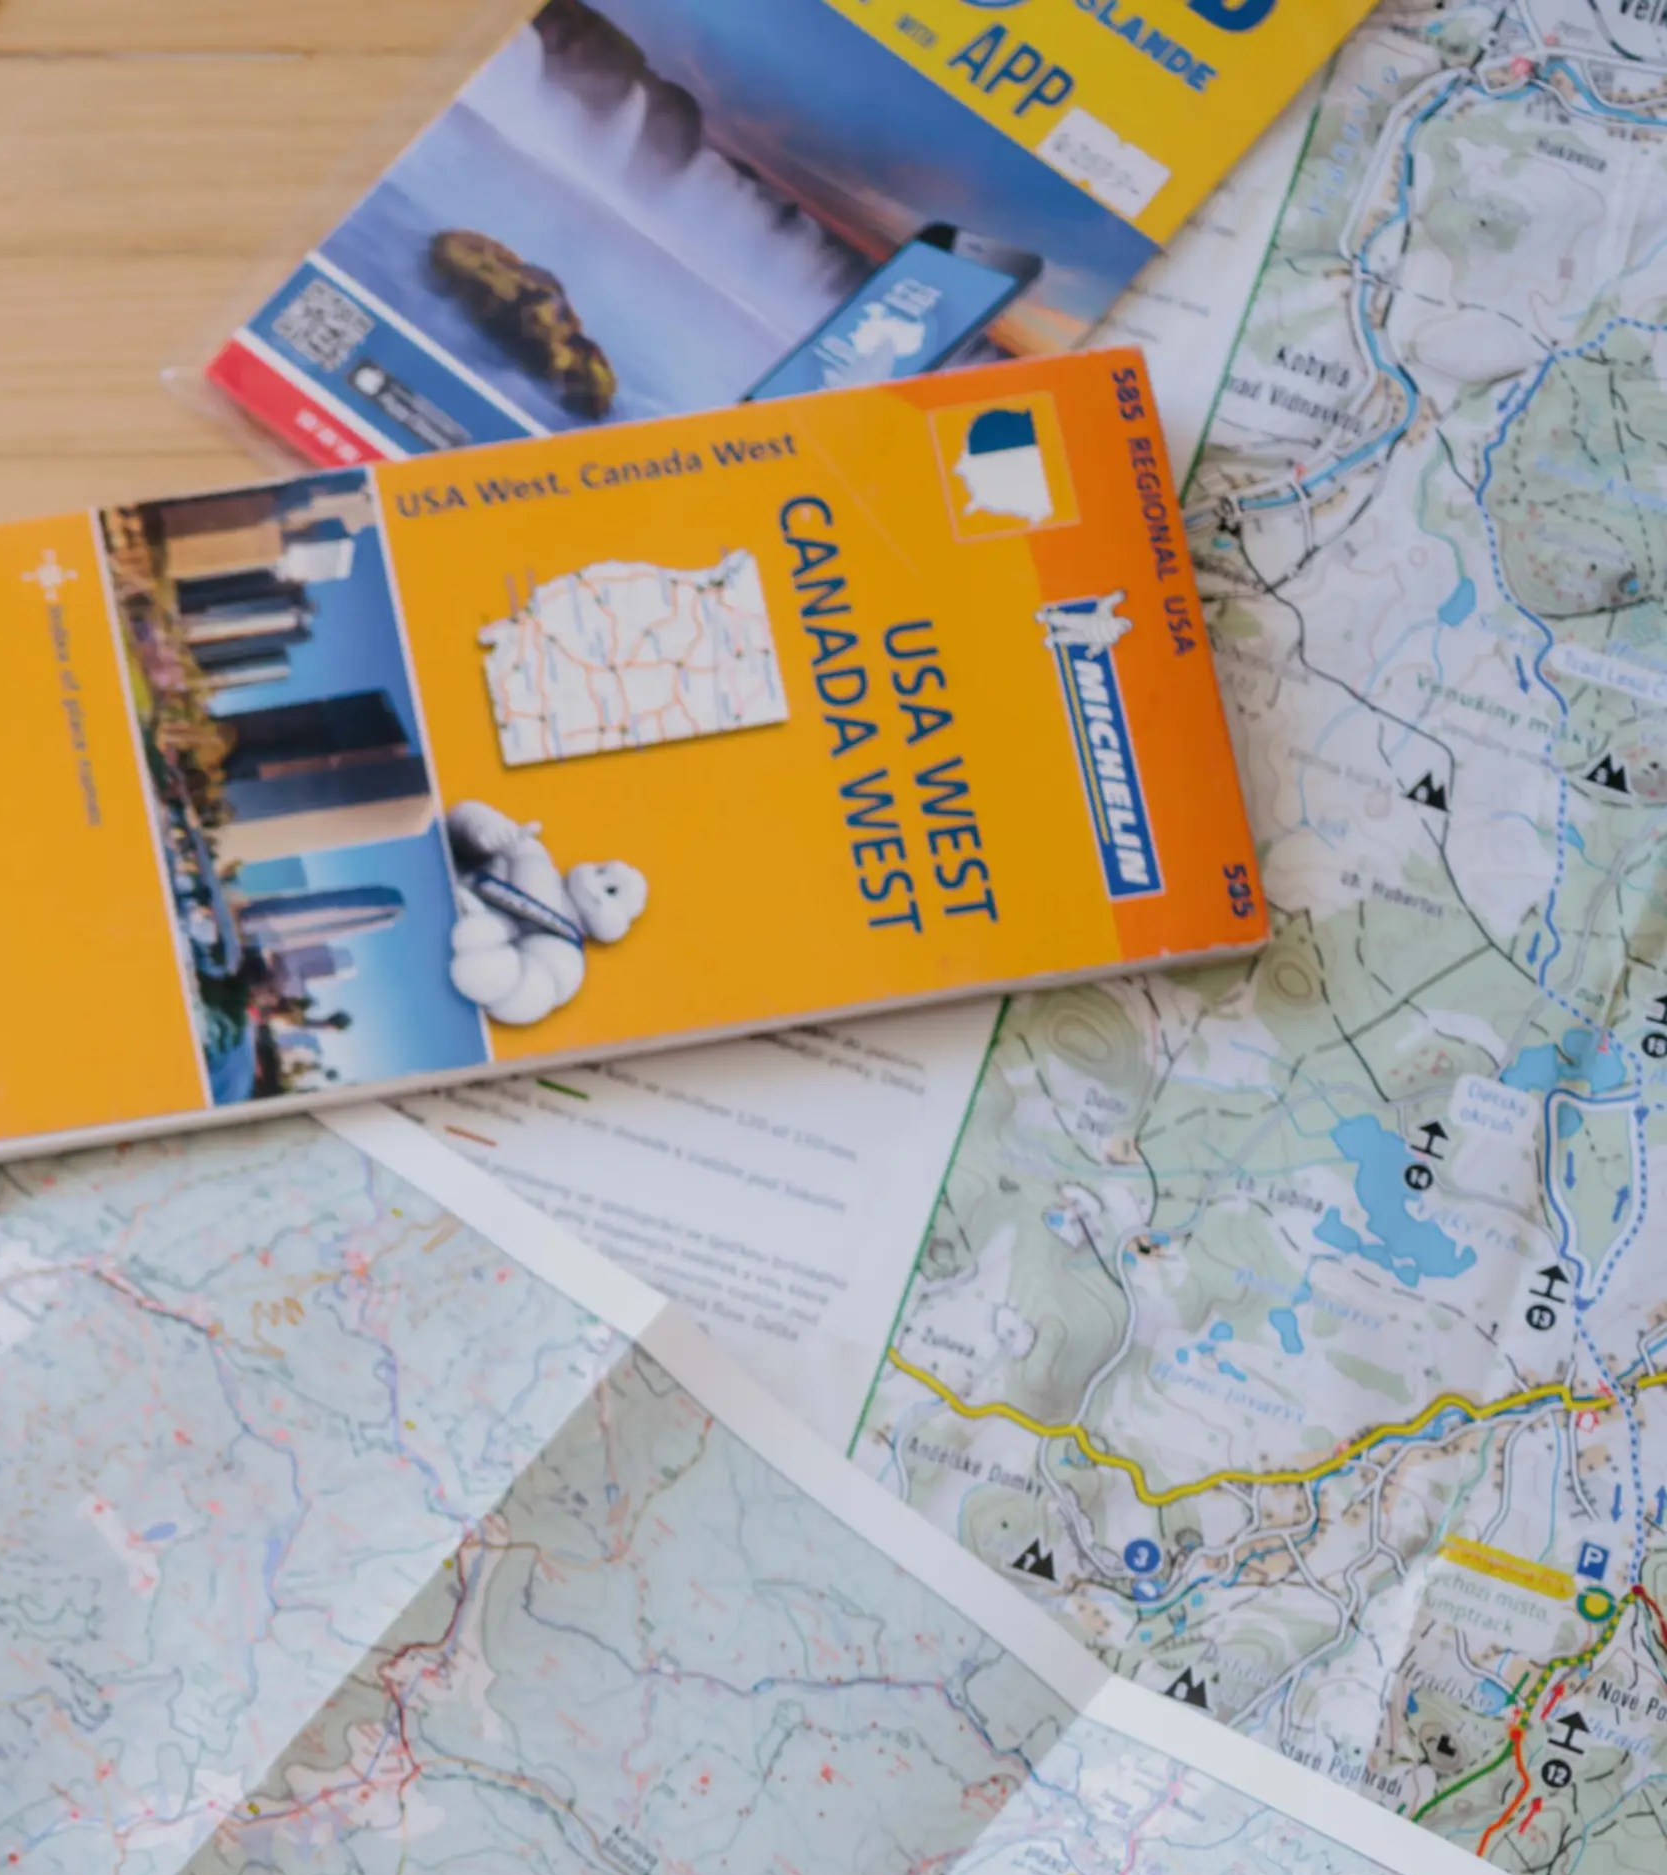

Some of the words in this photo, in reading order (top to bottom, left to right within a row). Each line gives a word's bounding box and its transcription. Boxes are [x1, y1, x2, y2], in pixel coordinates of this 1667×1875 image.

[947, 22, 1075, 117] APP
[394, 480, 470, 523] USA
[577, 442, 706, 495] Canada
[710, 427, 800, 471] West
[1110, 366, 1143, 422] 585
[1127, 434, 1180, 581] REGIONAL
[1163, 593, 1198, 657] USA
[775, 490, 882, 758] CANADA
[838, 767, 922, 943] WEST
[881, 616, 957, 746] USA
[1072, 653, 1150, 889] MICHELIN
[915, 754, 998, 930] WEST
[1222, 860, 1254, 921] 585
[1581, 1545, 1605, 1572] P
[1424, 1592, 1516, 1638] umptrack
[1545, 1764, 1569, 1784] 12
